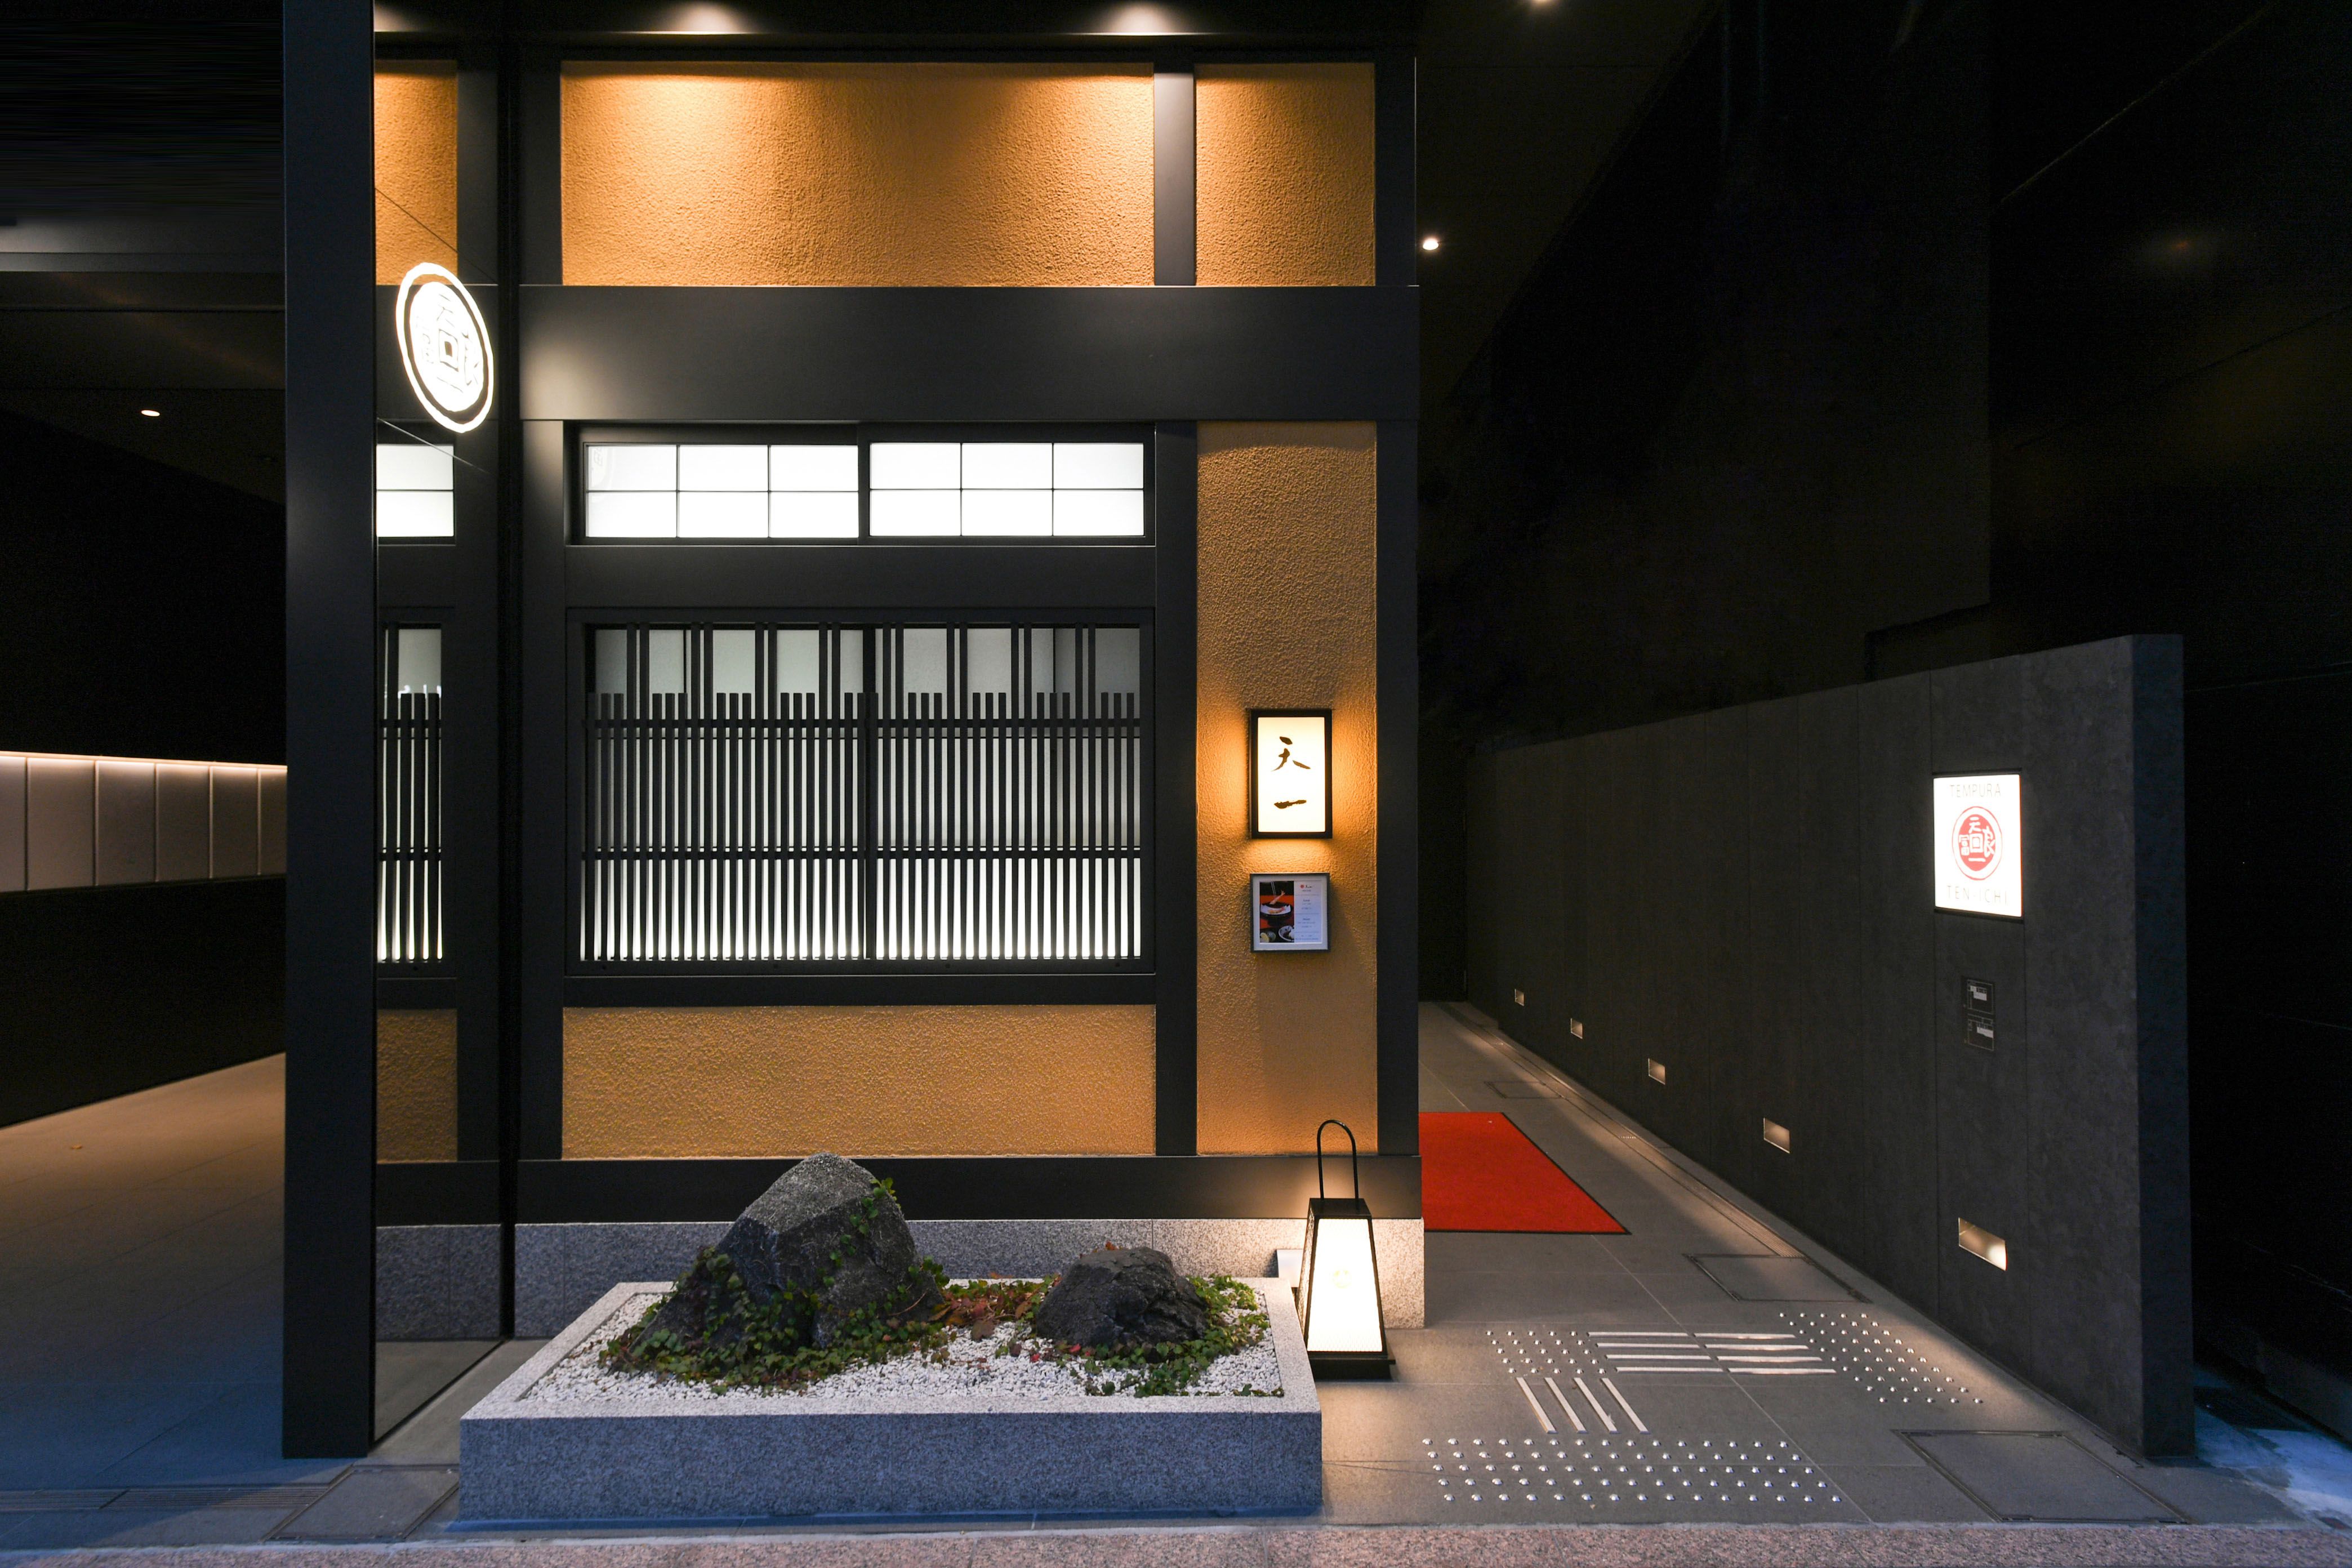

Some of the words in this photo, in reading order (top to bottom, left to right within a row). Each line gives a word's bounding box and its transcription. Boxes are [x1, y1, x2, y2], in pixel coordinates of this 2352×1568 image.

[1271, 736, 1311, 809] 天一
[1949, 783, 2001, 798] TEMPURA
[1946, 885, 2008, 906] TEN-ICHI
